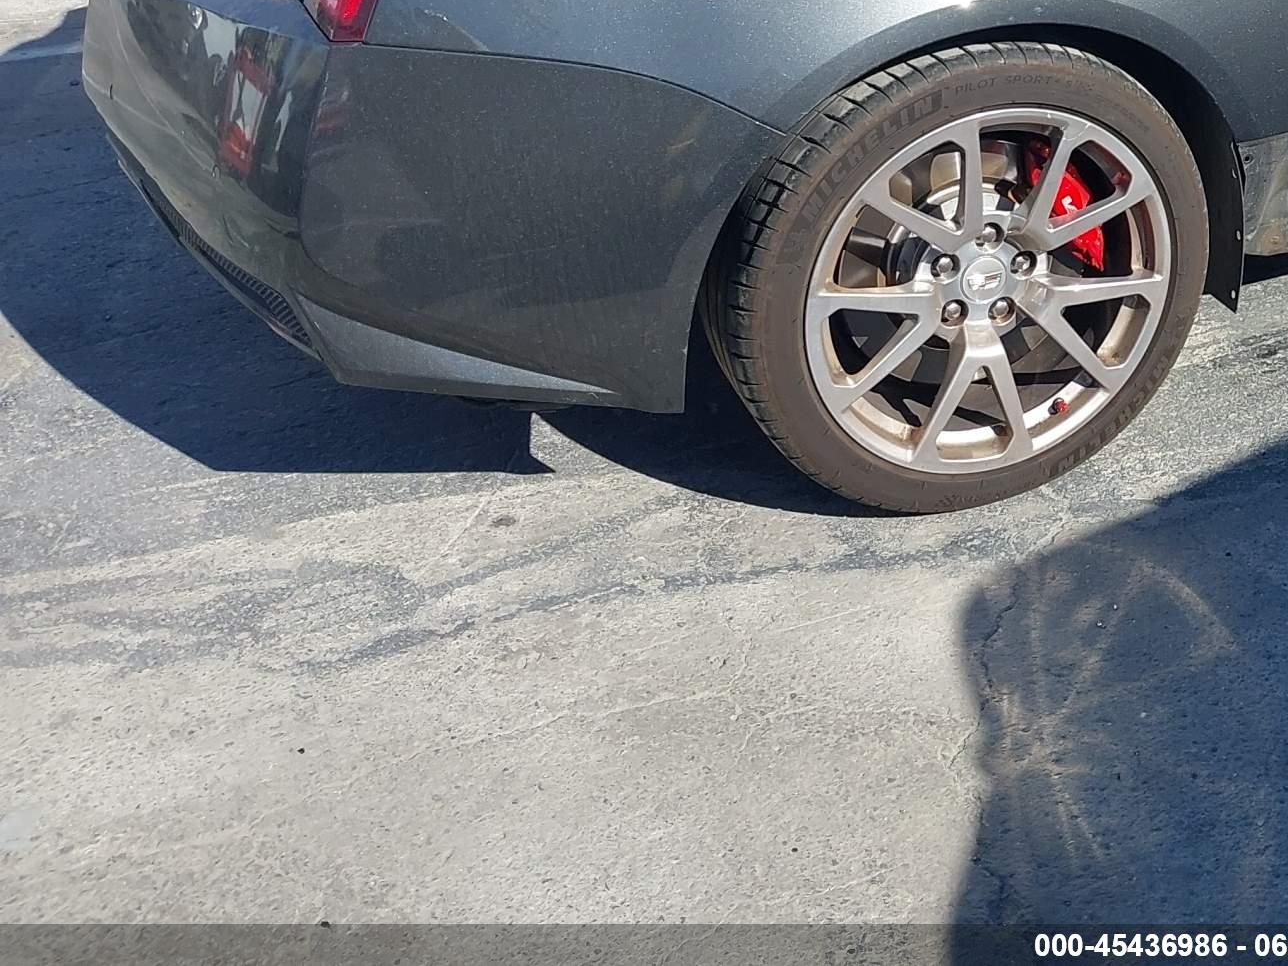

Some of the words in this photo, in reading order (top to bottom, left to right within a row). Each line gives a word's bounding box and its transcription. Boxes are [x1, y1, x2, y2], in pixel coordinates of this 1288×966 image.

[955, 77, 998, 97] PILOT
[1006, 74, 1053, 85] SPORT
[801, 94, 936, 220] MICHELIN
